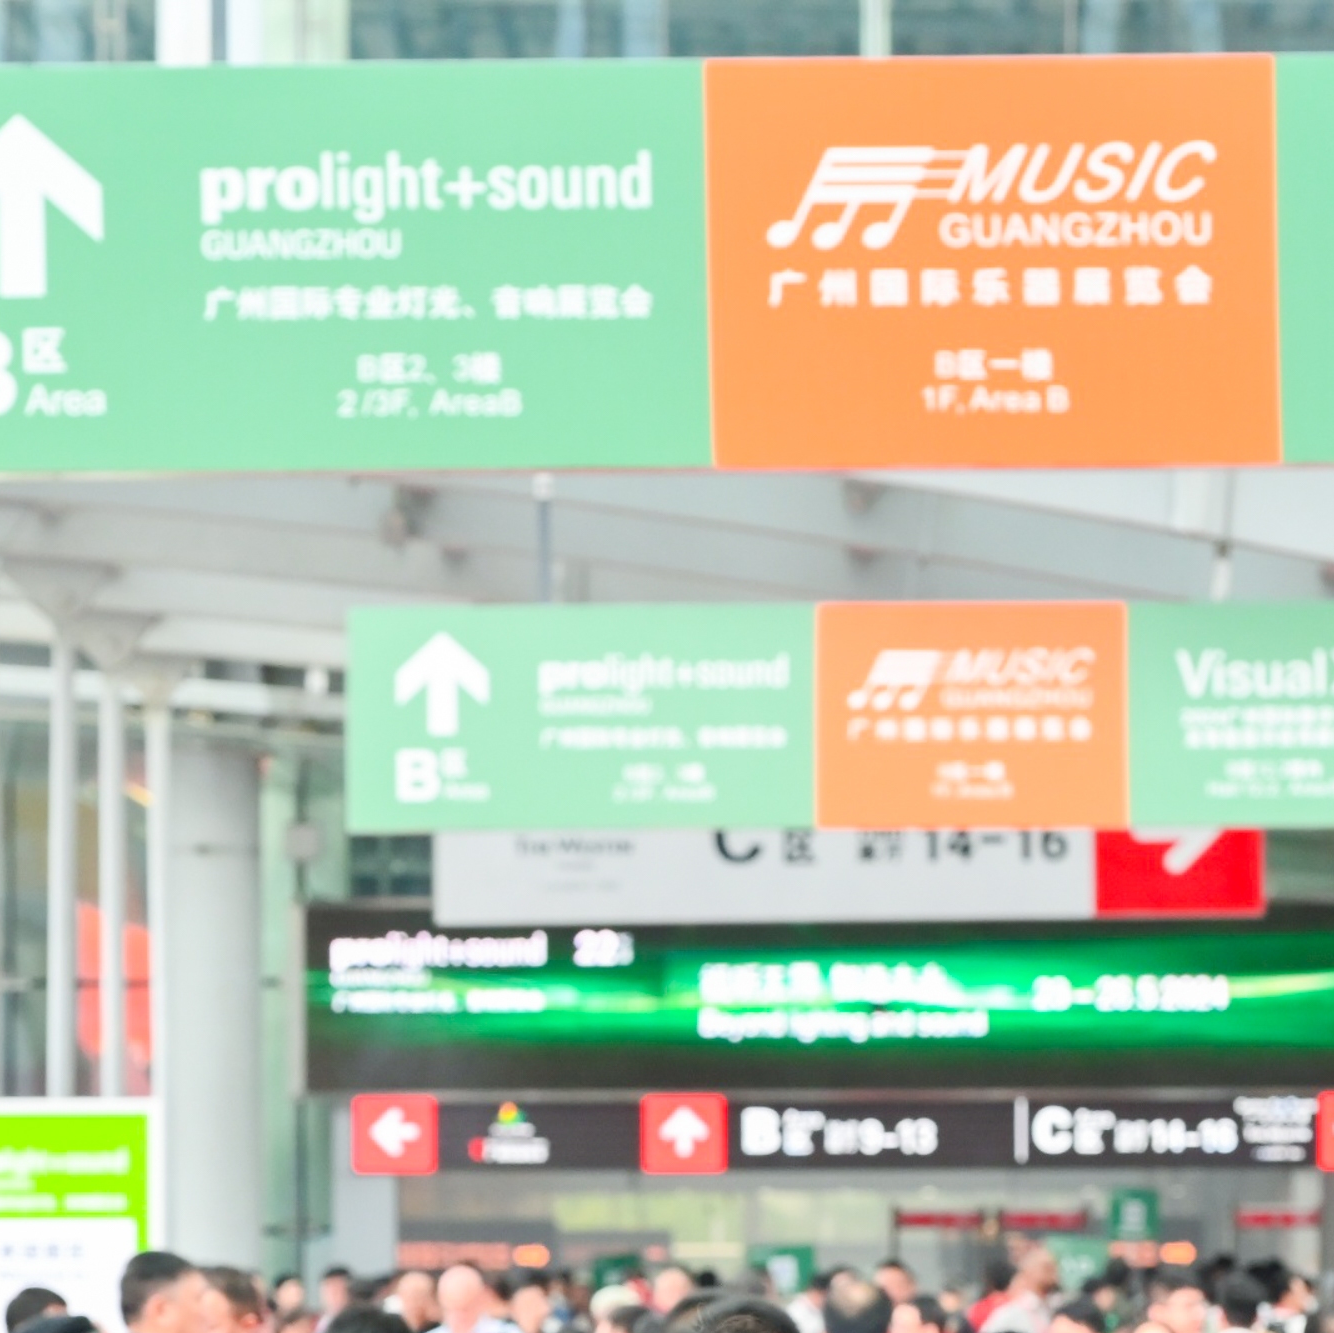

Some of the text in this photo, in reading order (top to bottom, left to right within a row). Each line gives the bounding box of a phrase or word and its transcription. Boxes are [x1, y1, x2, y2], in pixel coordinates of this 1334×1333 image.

[201, 150, 652, 224] prolight+sound
[947, 142, 1218, 203] MUSIC
[201, 229, 402, 259] GUANGZHOU
[939, 211, 1213, 247] GUANGZHOU
[24, 383, 107, 417] Area
[971, 386, 1041, 412] Area
[1047, 386, 1070, 412] B
[946, 647, 1096, 685] MUSIC
